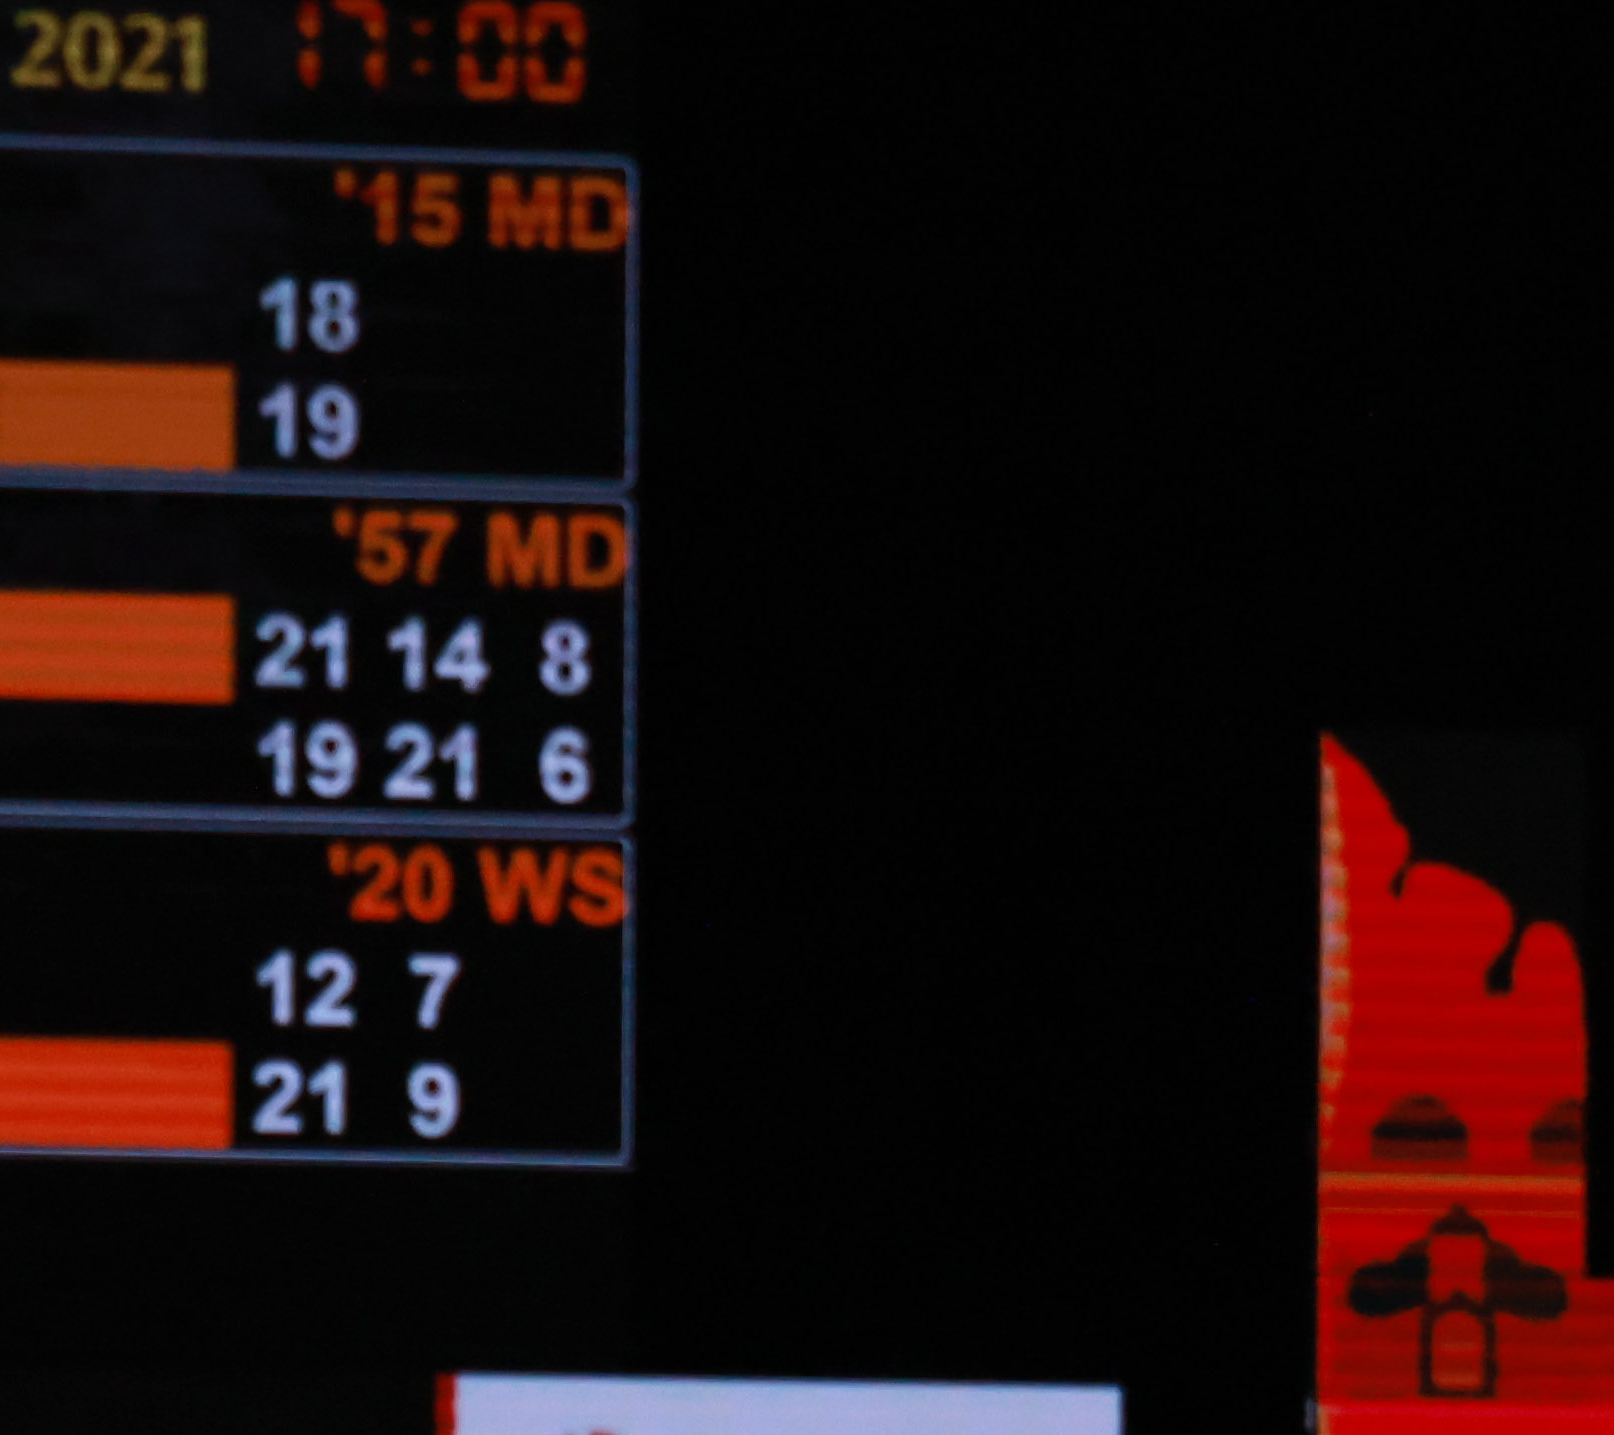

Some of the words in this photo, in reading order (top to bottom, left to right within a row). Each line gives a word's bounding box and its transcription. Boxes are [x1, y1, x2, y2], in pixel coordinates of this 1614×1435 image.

[10, 10, 207, 92] 2021
[297, 0, 586, 103] 17:00
[334, 168, 460, 246] '15
[488, 176, 628, 252] MD
[258, 278, 360, 354] 18
[258, 384, 360, 459] 19
[332, 508, 460, 583] '57
[488, 515, 628, 588] MD
[254, 614, 350, 688] 21
[386, 618, 490, 691] 14
[539, 621, 591, 696] 8
[257, 721, 358, 797] 19
[383, 726, 481, 800] 21
[538, 729, 591, 803] 6
[328, 844, 454, 922] '20
[477, 848, 628, 928] WS
[256, 951, 357, 1026] 12
[409, 955, 460, 1028] 7
[253, 1061, 350, 1135] 21
[407, 1064, 460, 1138] 9
